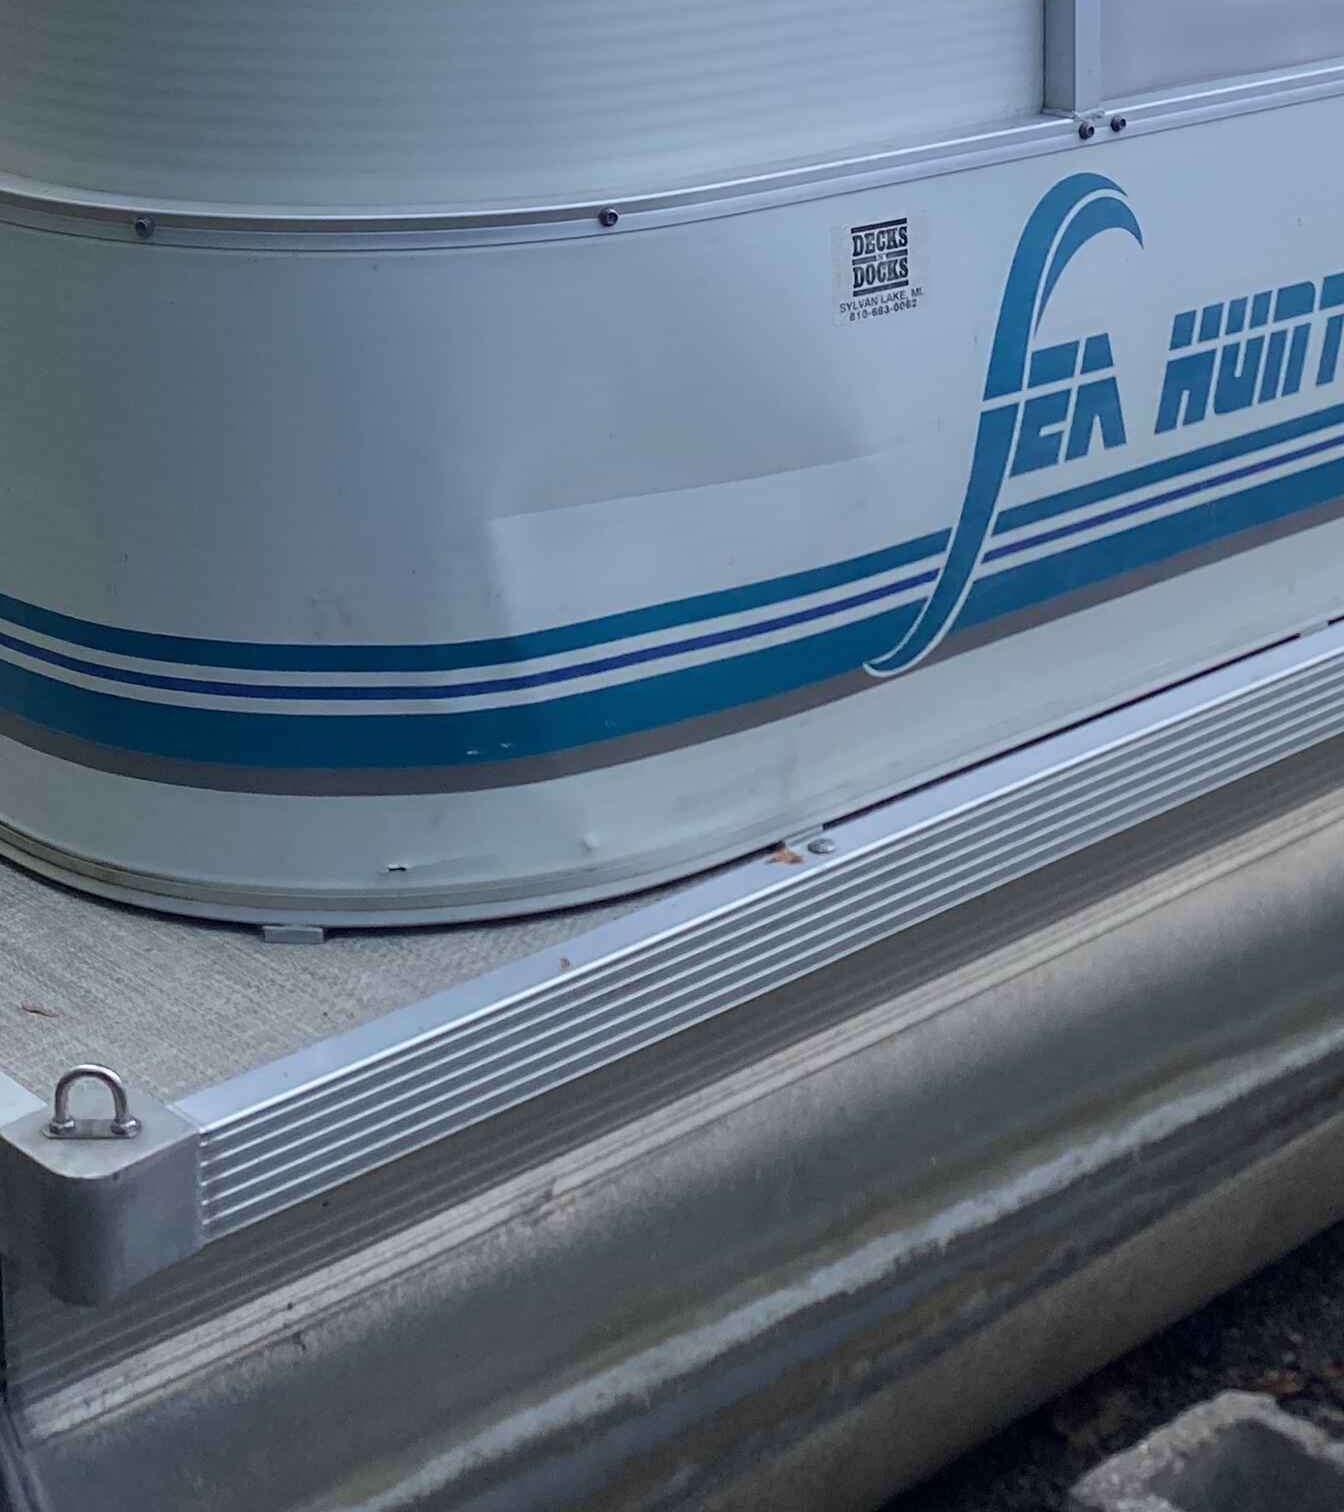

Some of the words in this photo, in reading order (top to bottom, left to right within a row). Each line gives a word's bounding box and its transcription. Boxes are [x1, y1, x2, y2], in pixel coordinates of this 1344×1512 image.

[852, 226, 907, 257] DECKS
[853, 257, 908, 288] DOCKS
[839, 296, 878, 313] SYLVAN
